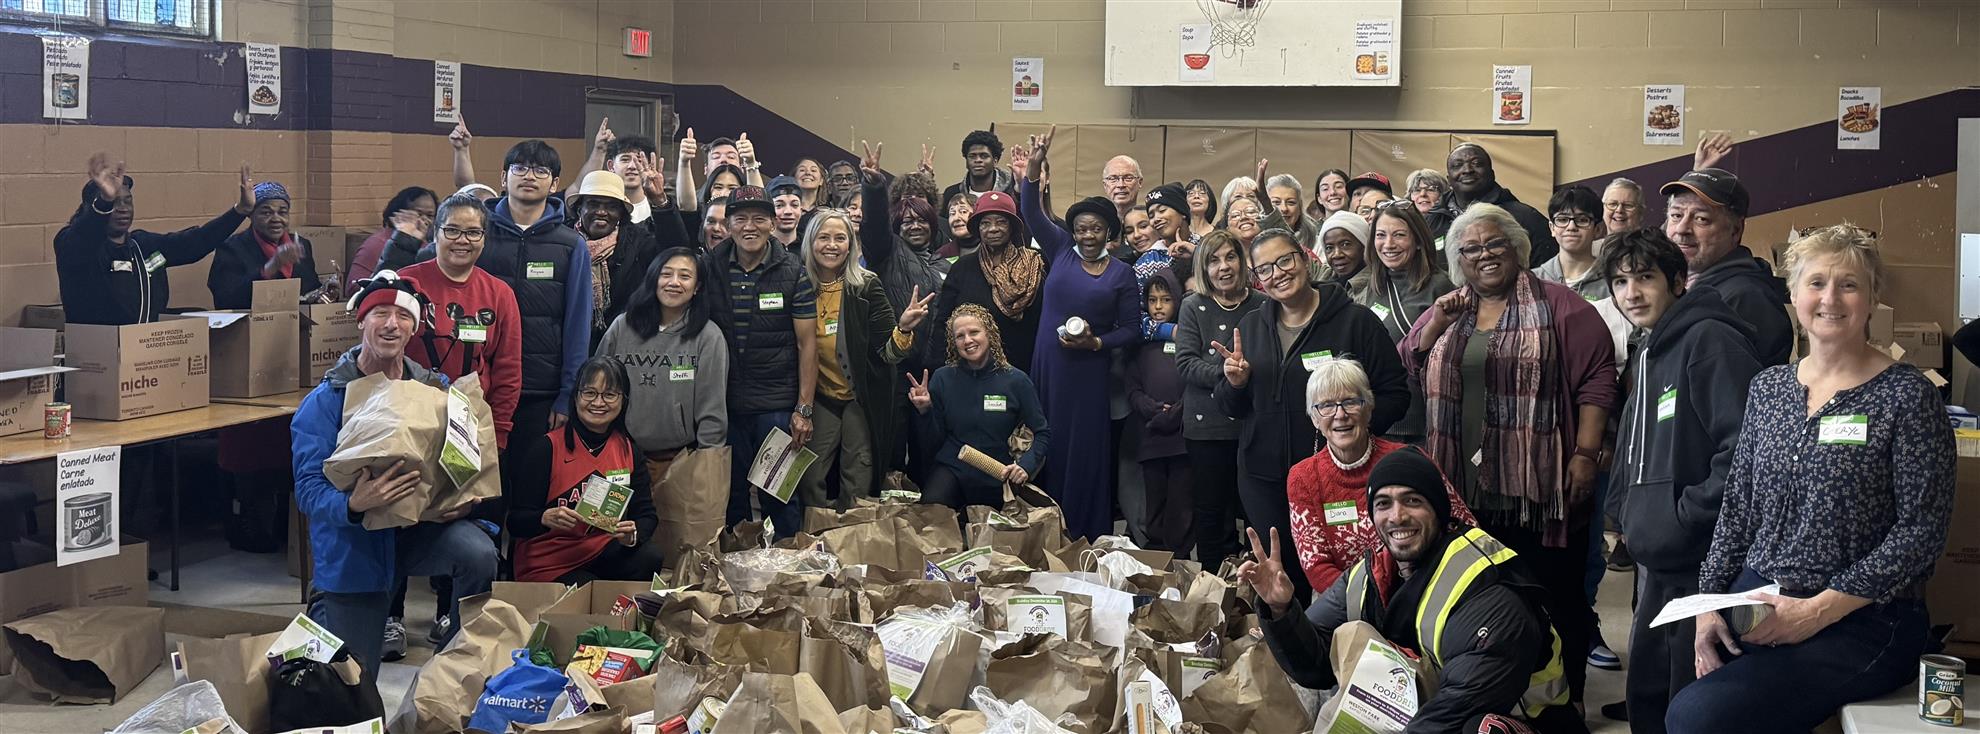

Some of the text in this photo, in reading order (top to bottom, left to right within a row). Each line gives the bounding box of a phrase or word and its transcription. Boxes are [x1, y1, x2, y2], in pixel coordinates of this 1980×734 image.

[632, 31, 650, 54] EXIT
[138, 332, 194, 344] MANTENER CONGELADO
[121, 375, 158, 392] niche
[60, 452, 116, 468] Canned Meat
[60, 469, 85, 480] Carne
[60, 477, 95, 491] enlatada
[79, 508, 96, 518] Meat
[75, 515, 101, 530] Deluxe
[1348, 700, 1368, 714] WESTON
[1368, 711, 1380, 721] PARK
